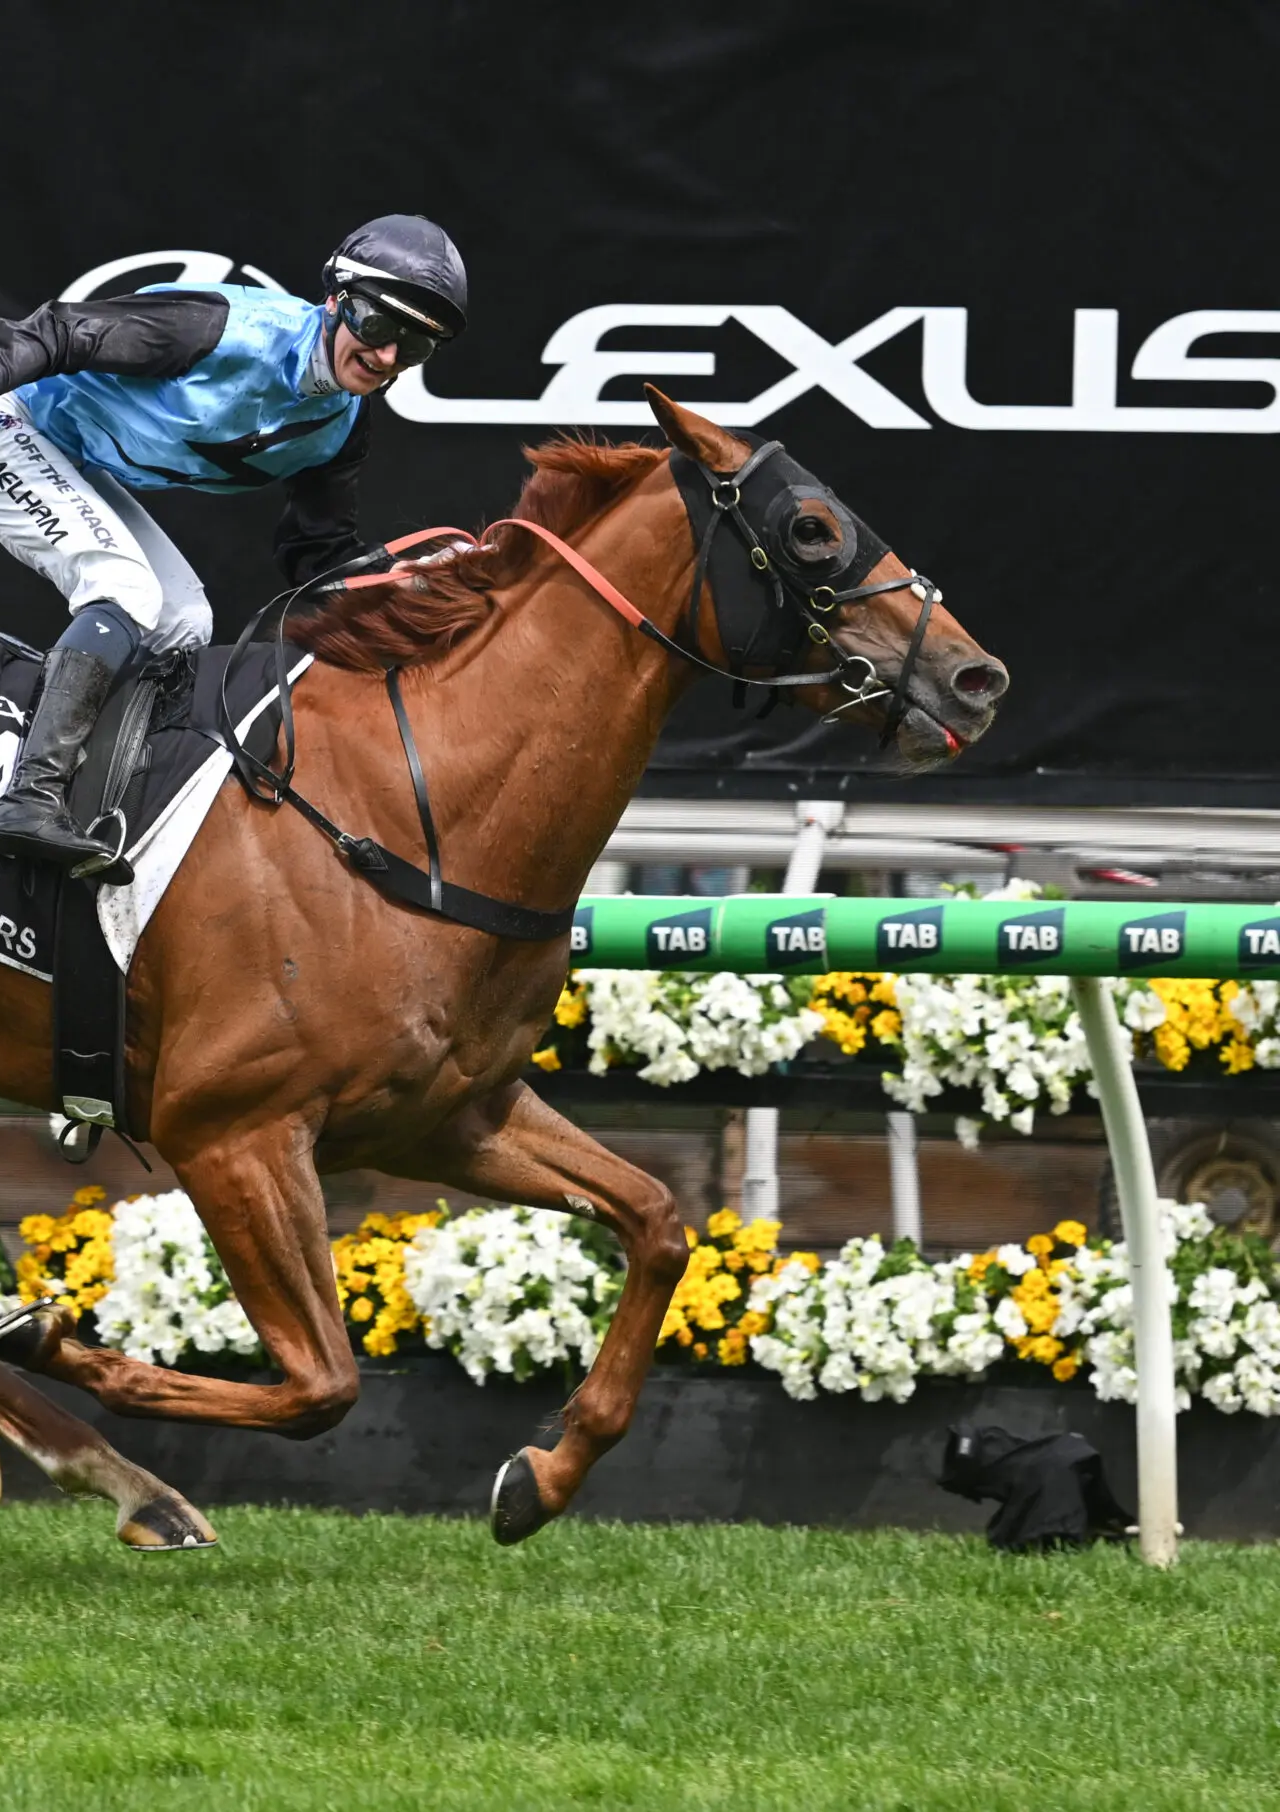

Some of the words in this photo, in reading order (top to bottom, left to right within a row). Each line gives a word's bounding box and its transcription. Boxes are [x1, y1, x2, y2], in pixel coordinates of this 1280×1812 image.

[13, 432, 45, 463] OFF
[39, 463, 75, 494] THE
[70, 495, 119, 549] TRACK
[652, 926, 706, 951] TAB
[772, 926, 826, 951] TAB
[882, 923, 938, 949] TAB
[1004, 925, 1058, 951] TAB
[1125, 927, 1180, 953] TAB
[1245, 929, 1280, 954] TA
